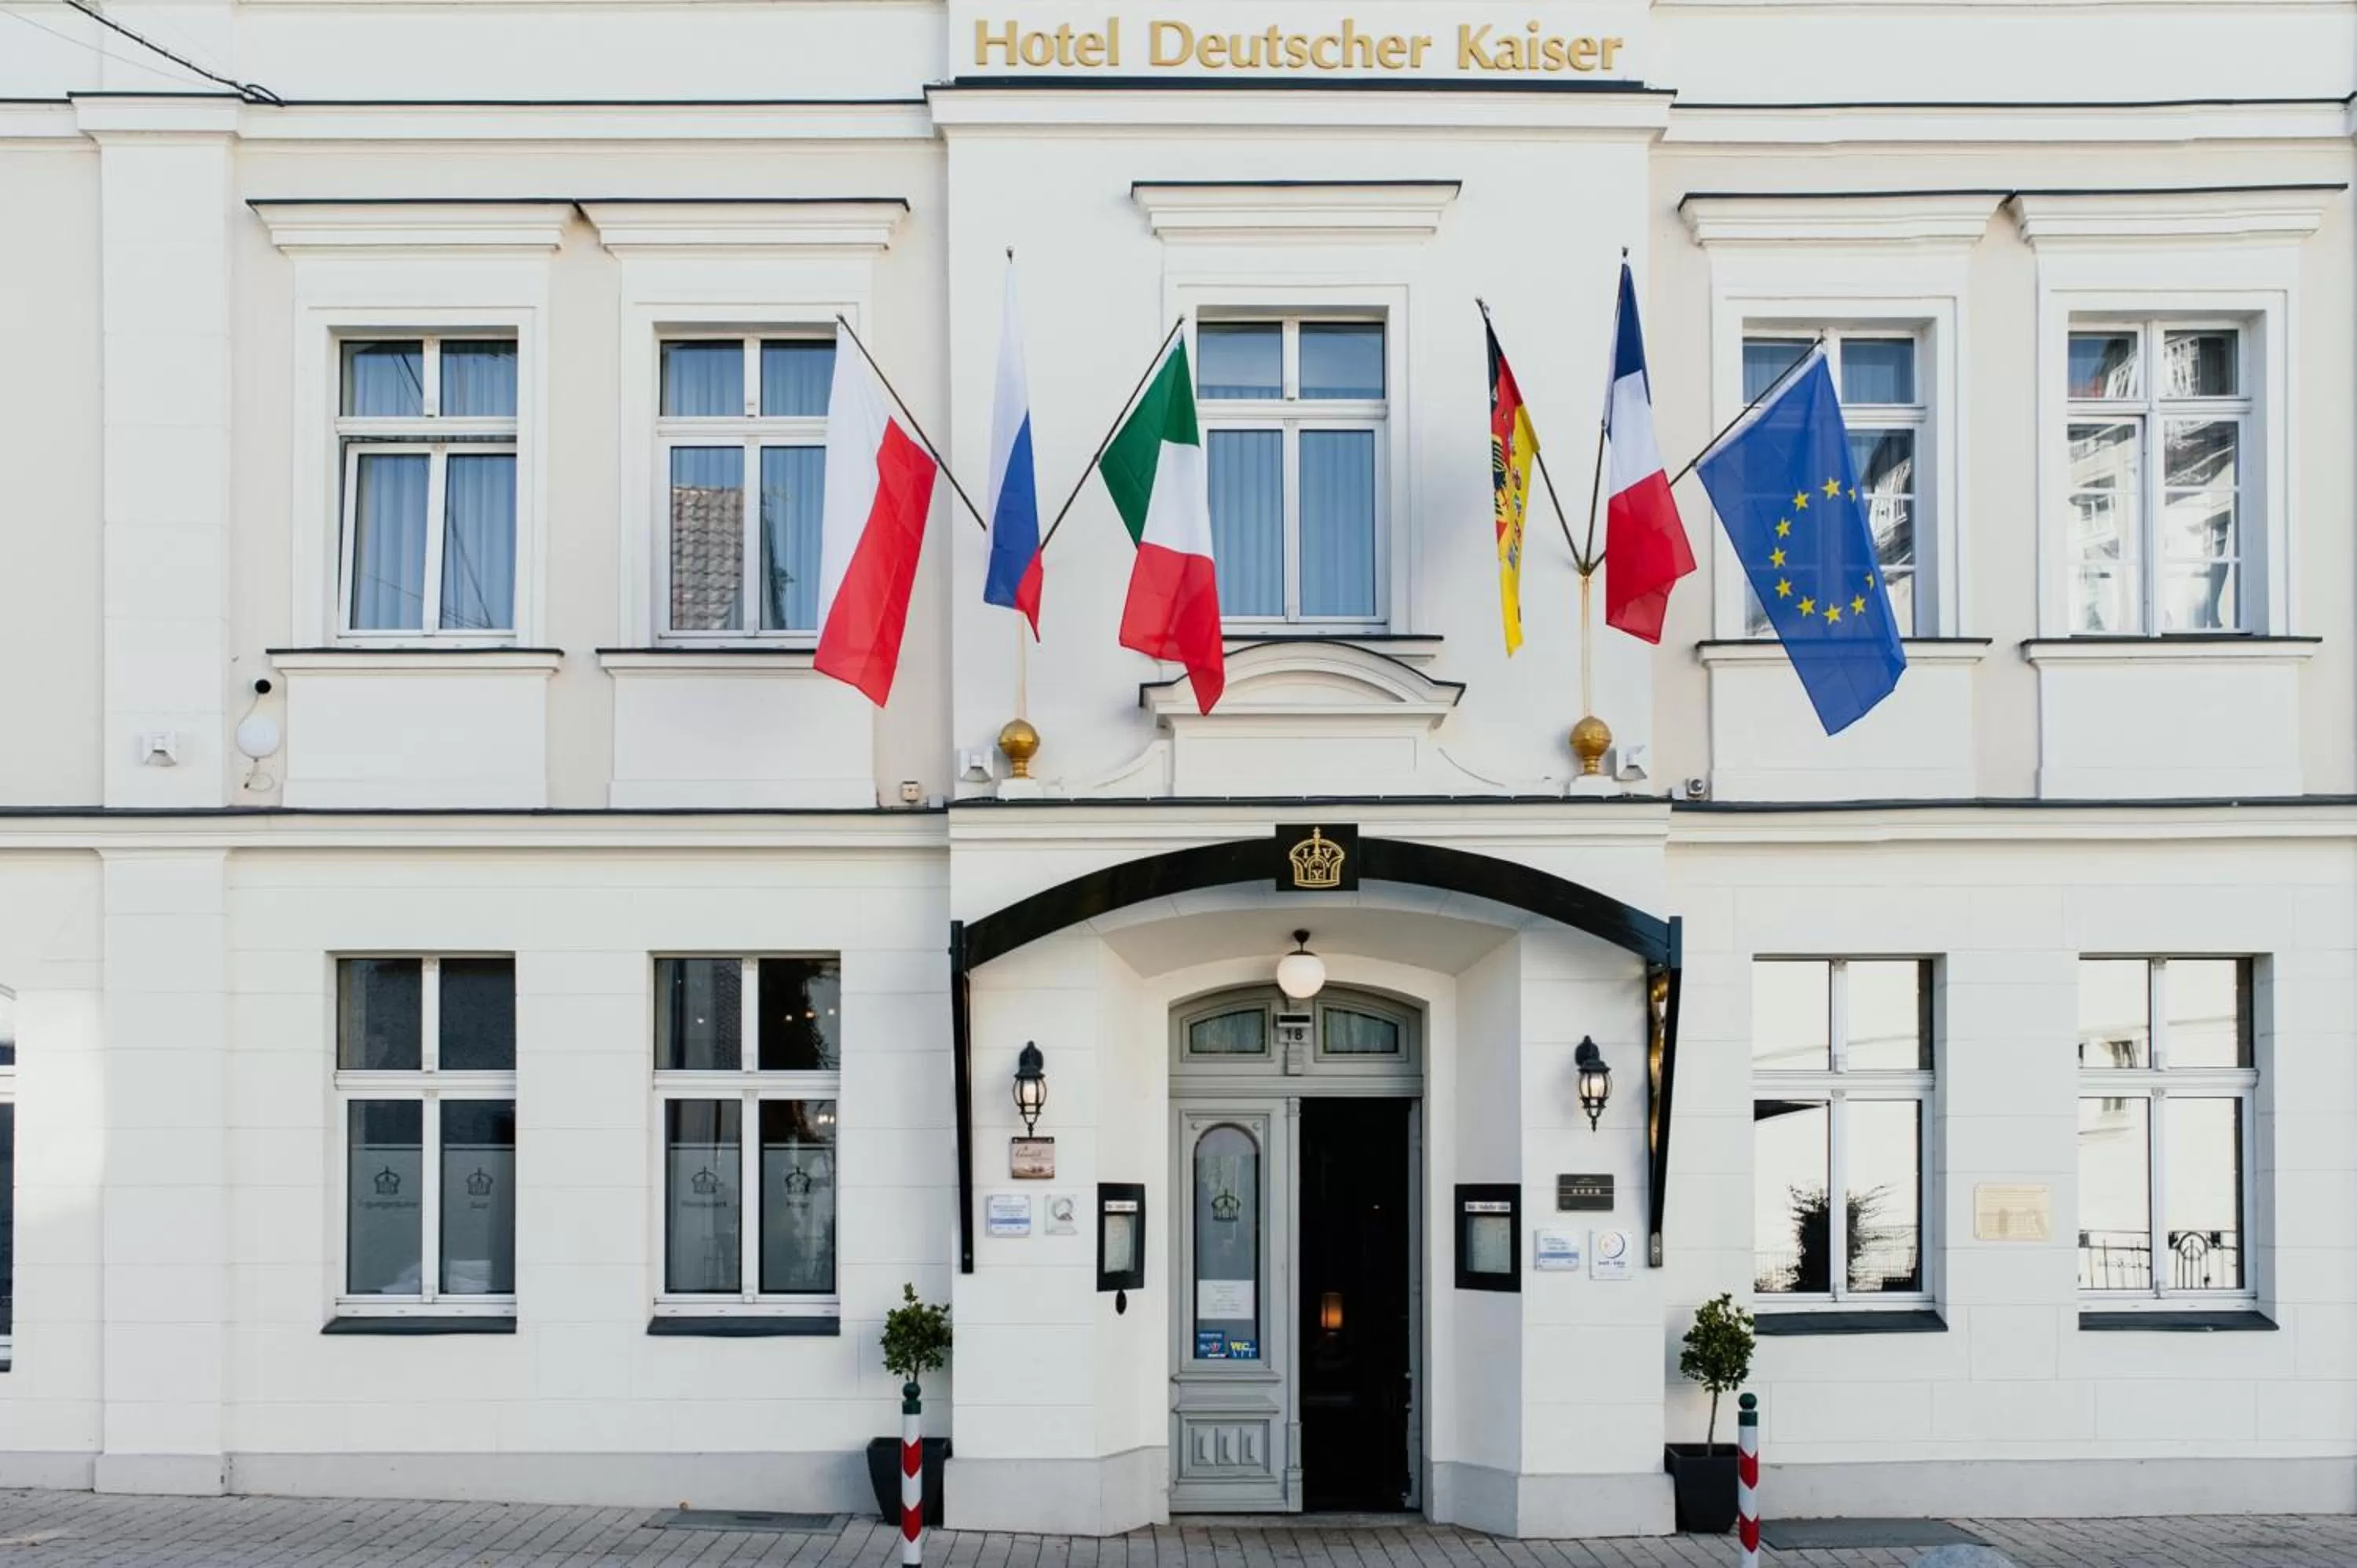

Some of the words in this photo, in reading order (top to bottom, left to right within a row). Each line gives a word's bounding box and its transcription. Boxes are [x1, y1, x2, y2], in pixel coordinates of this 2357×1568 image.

[975, 17, 1119, 67] Hotel
[1149, 19, 1432, 69] Deutscher
[1457, 20, 1623, 71] Kaiser
[1285, 1028, 1303, 1040] 18
